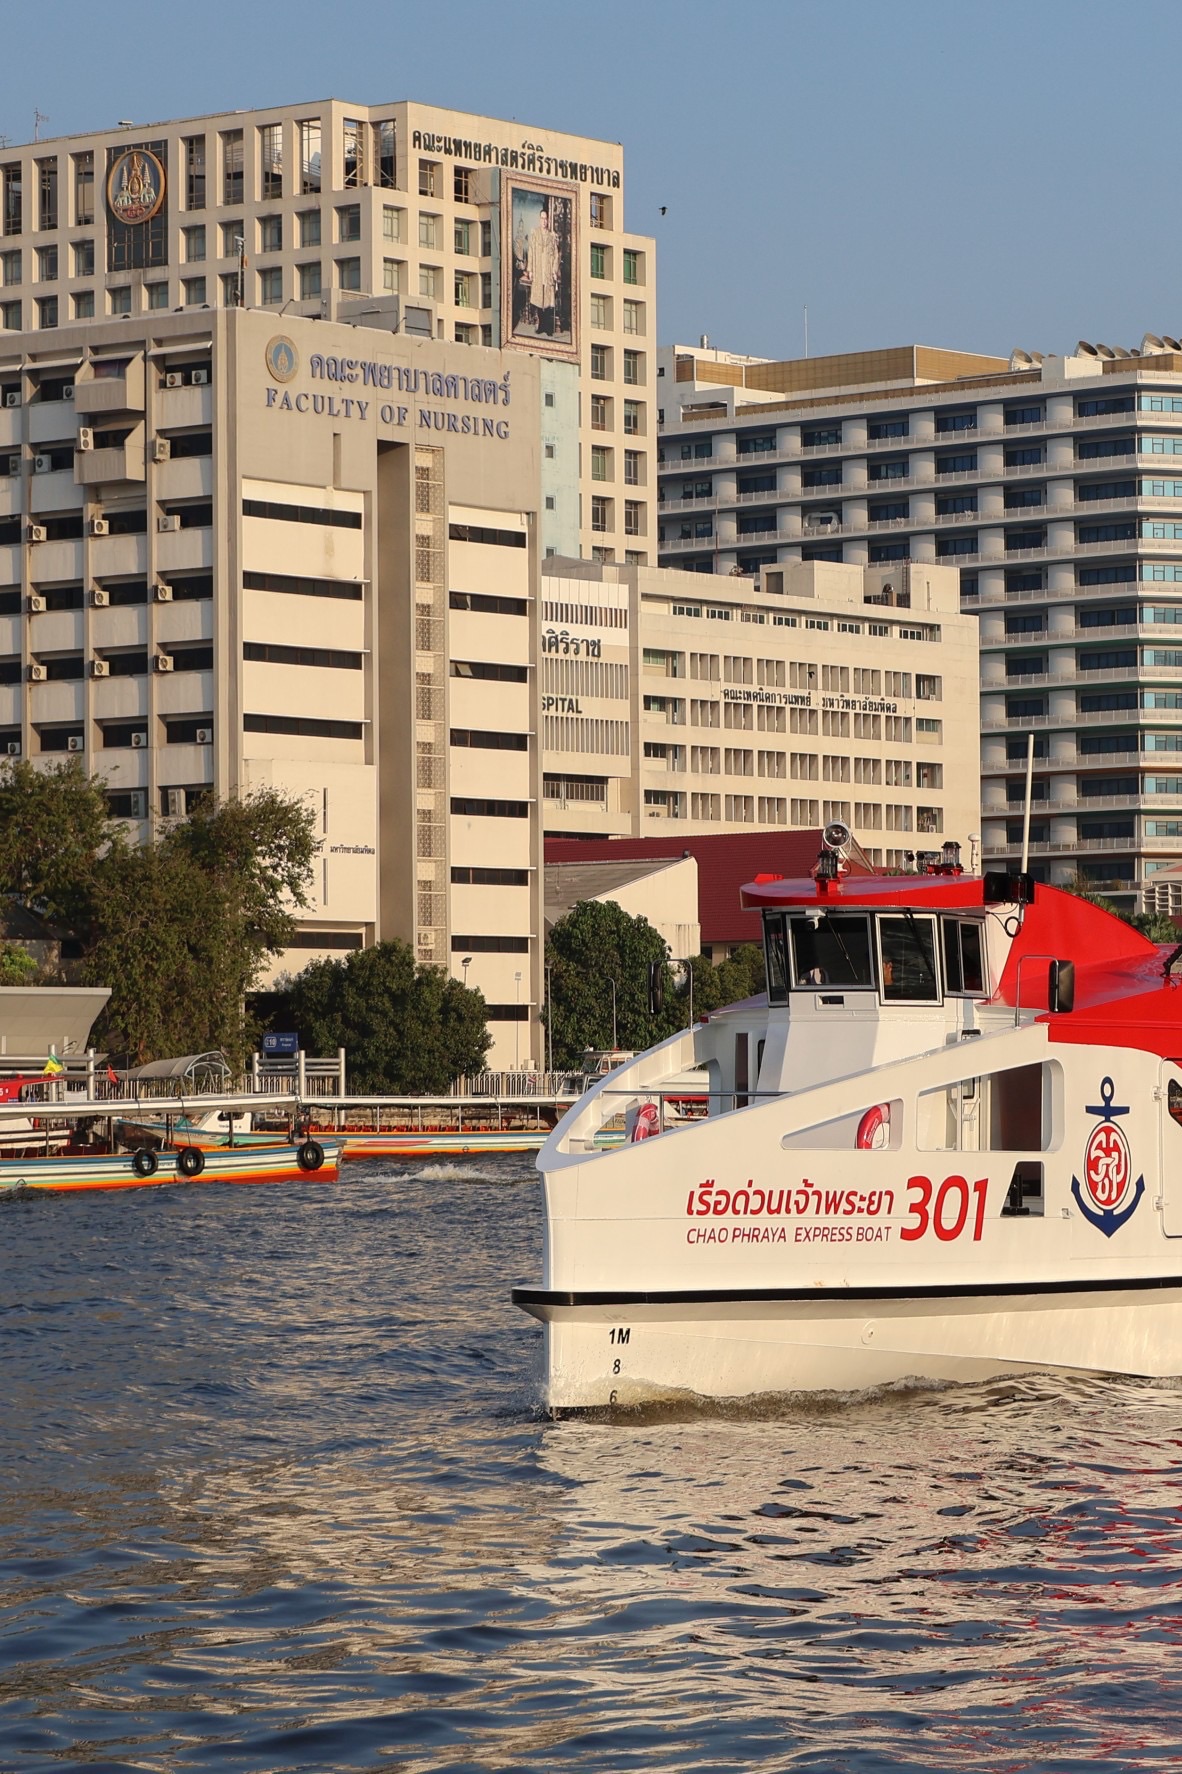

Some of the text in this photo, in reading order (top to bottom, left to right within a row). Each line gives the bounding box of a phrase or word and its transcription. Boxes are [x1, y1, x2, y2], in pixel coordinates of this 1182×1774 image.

[412, 130, 620, 188] คณะแพทยศาสตร์ศิริราชพยาบาล
[310, 353, 511, 406] คณะพยาบาลศาสตร์
[265, 387, 511, 440] FACULTY OF NURSING
[686, 1178, 895, 1216] เรือด่วนเจ้าพระยา
[899, 1175, 989, 1242] 301
[686, 1226, 892, 1244] CHAO PHRAYA EXPRESS BOAT
[609, 1327, 631, 1345] 1M
[612, 1358, 621, 1375] 8
[609, 1389, 618, 1404] 6
